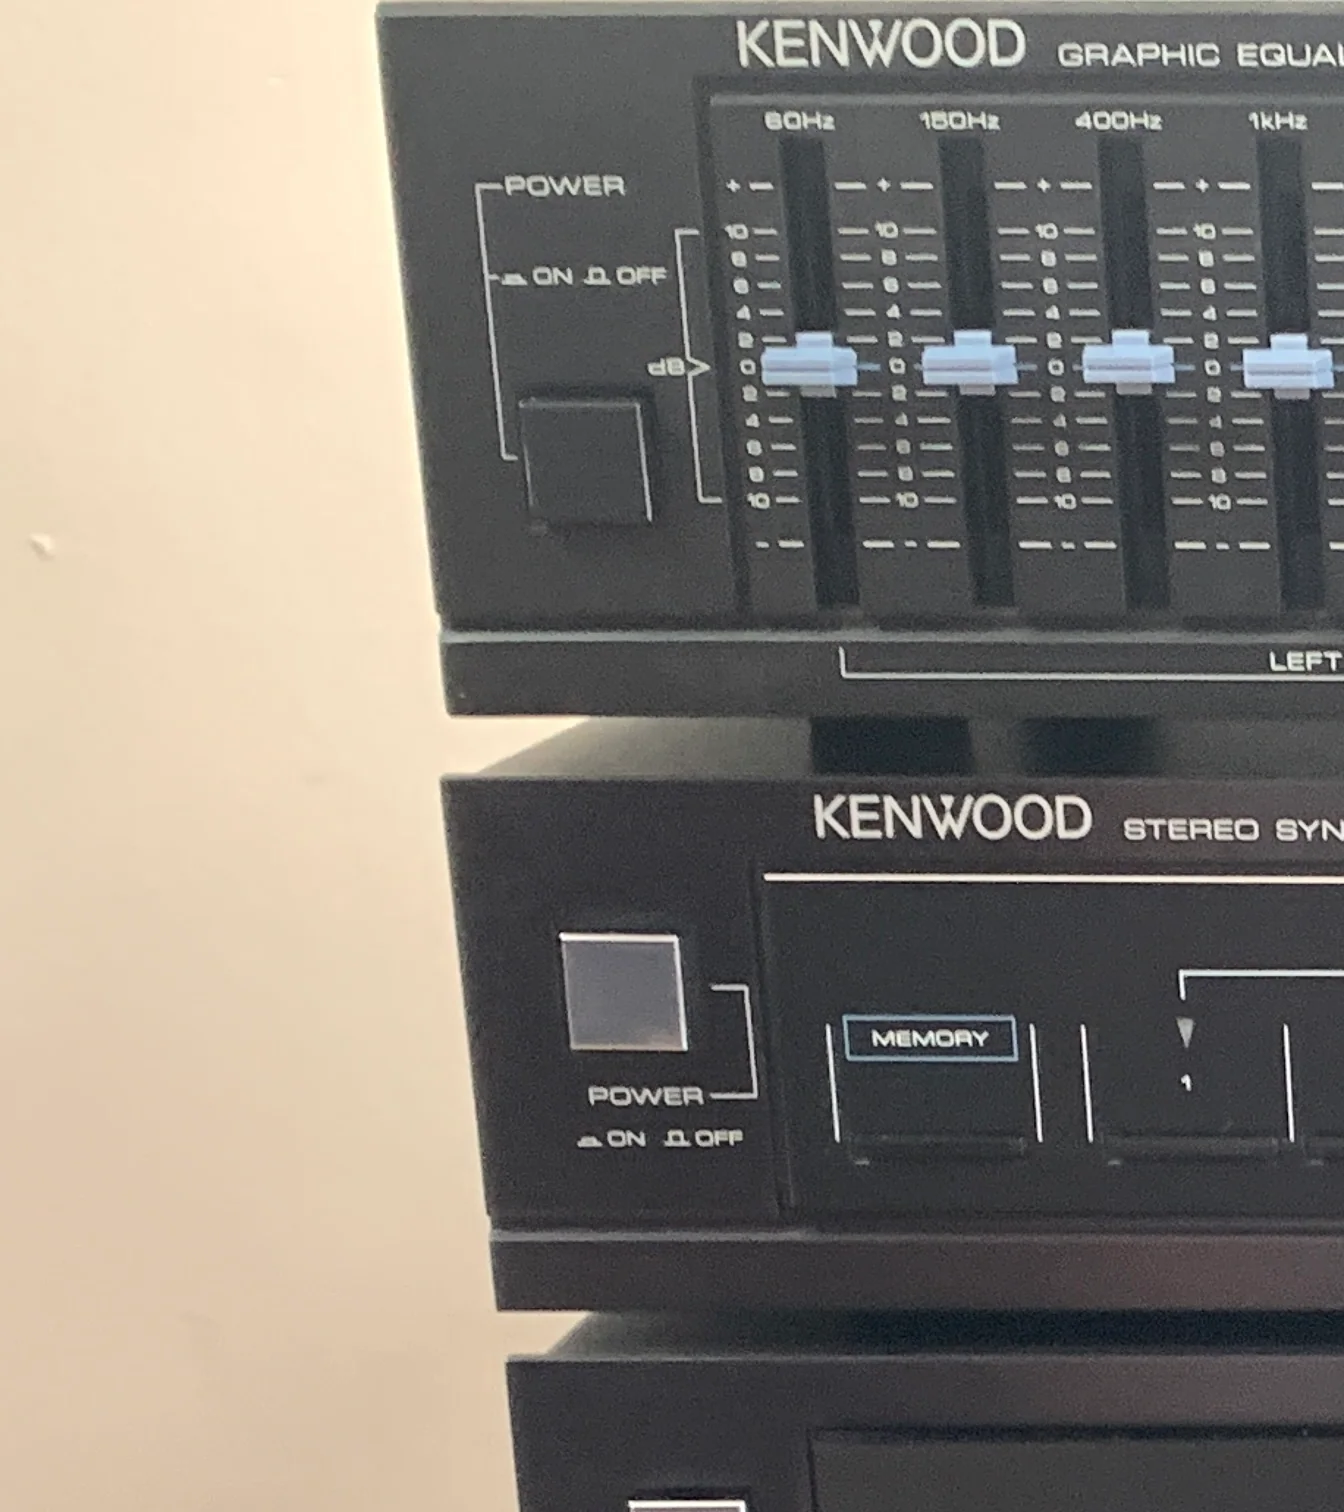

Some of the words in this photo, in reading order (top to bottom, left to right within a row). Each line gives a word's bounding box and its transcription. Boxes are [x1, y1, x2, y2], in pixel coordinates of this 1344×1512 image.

[737, 18, 1025, 67] KENWOOD
[1059, 43, 1220, 66] GRAPHIC
[765, 111, 835, 130] 60Hz
[920, 111, 1000, 129] 150Hz
[1076, 111, 1162, 130] 400Hz
[1249, 112, 1307, 130] 1kHz
[505, 175, 625, 196] POWER
[533, 267, 573, 285] ON
[616, 266, 667, 285] OFF
[1270, 651, 1342, 671] LEFT
[814, 794, 1092, 840] KENWOOD
[1124, 819, 1259, 844] STEREO
[872, 1030, 989, 1047] MEMORY
[588, 1086, 704, 1105] POWER
[607, 1130, 646, 1147] ON
[695, 1130, 743, 1147] OFF
